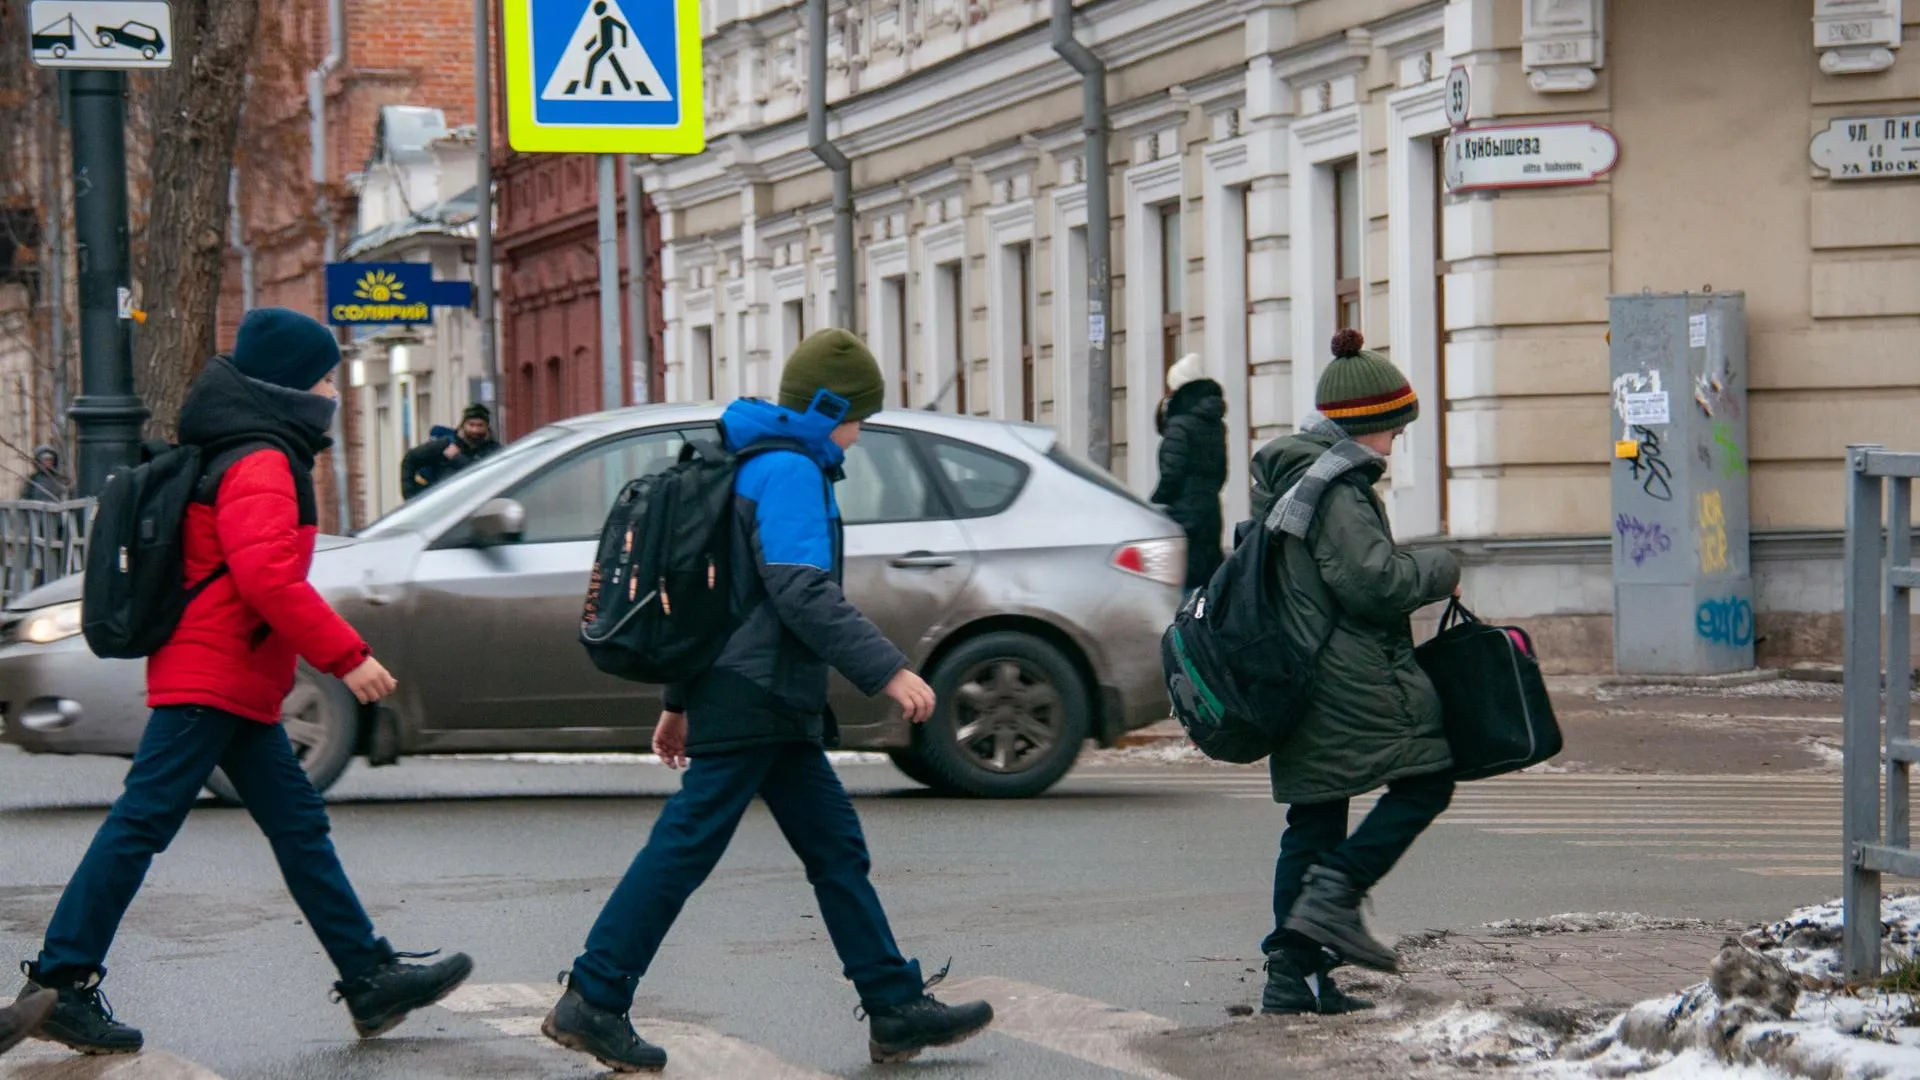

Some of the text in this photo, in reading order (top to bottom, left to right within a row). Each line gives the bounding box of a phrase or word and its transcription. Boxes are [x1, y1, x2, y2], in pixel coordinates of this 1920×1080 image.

[1453, 79, 1463, 113] 55
[1465, 137, 1541, 160] Куйбышева
[332, 302, 428, 320] СОЛЯРИЙ
